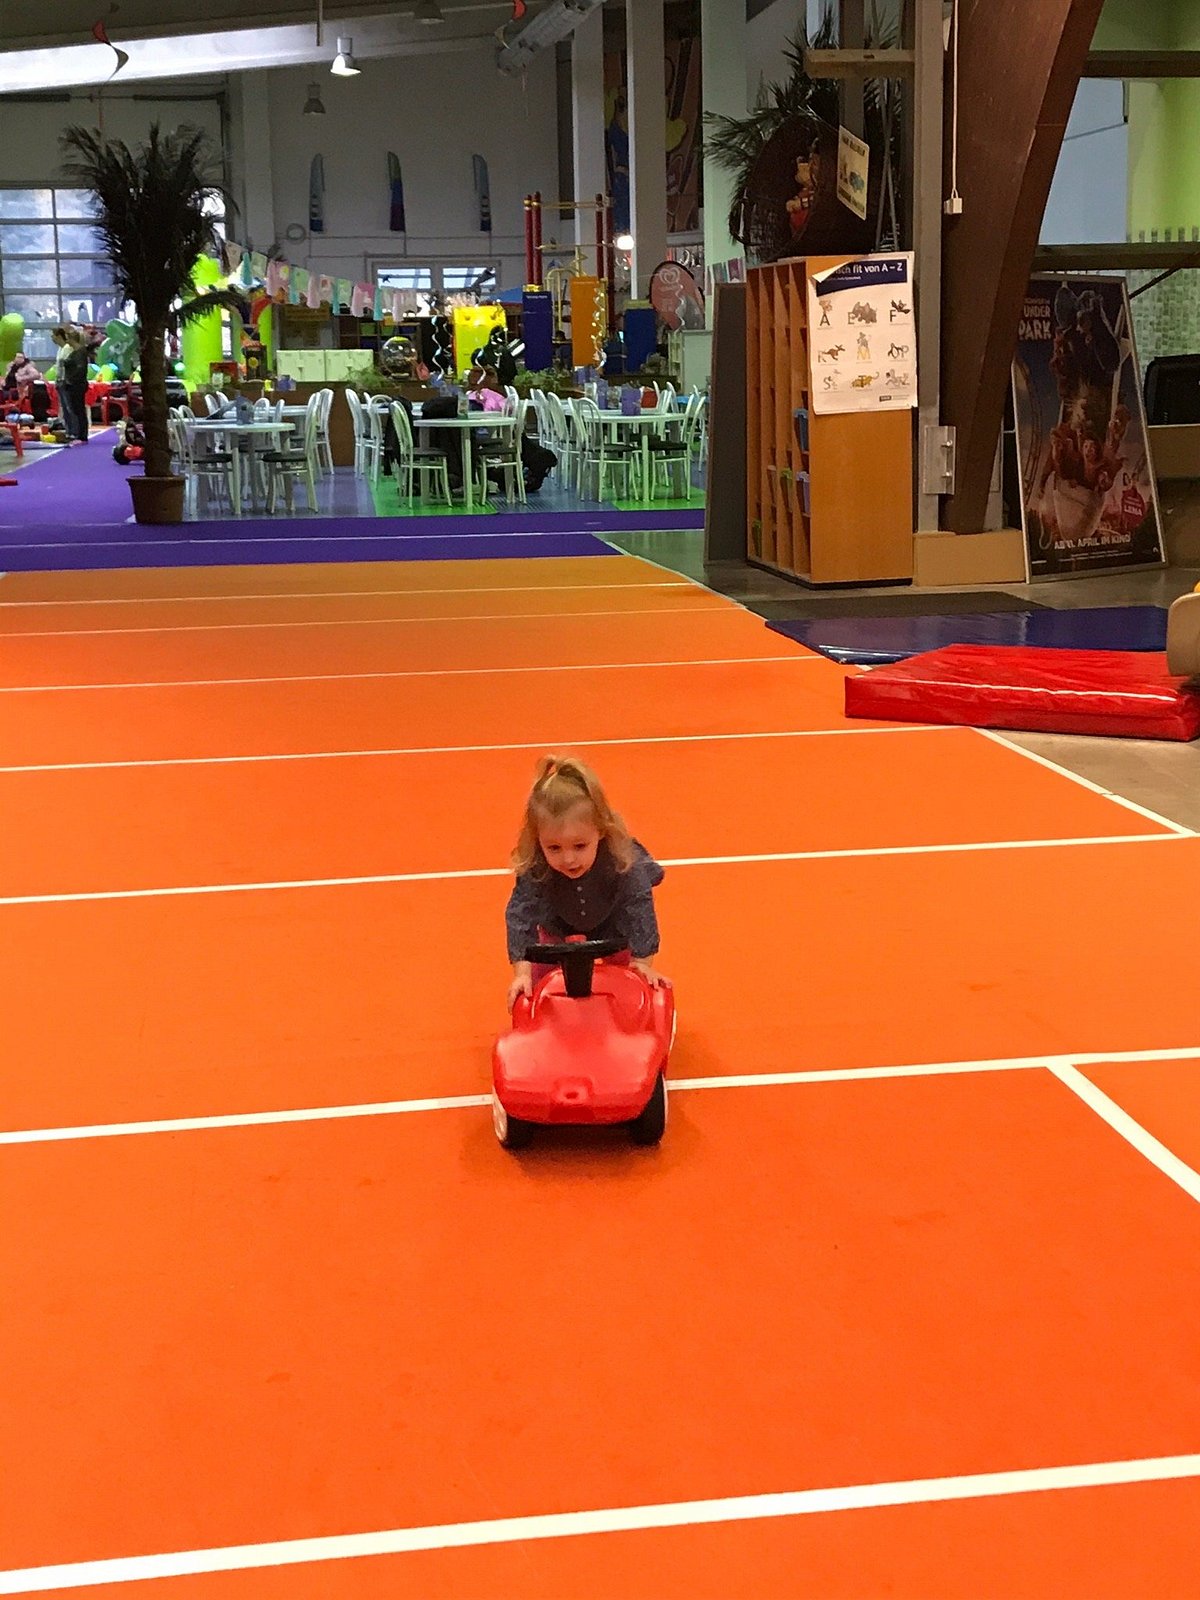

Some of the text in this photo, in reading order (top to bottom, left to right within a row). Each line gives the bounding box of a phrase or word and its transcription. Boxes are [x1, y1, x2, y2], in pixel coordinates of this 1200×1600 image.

[852, 263, 863, 274] fit
[864, 265, 880, 273] von
[881, 263, 888, 273] A
[896, 262, 903, 271] Z
[889, 309, 897, 322] F
[1023, 304, 1051, 318] UNDER
[820, 313, 831, 327] A
[1078, 536, 1100, 547] APRIL
[1101, 535, 1111, 545] IM
[1111, 533, 1132, 544] KINO
